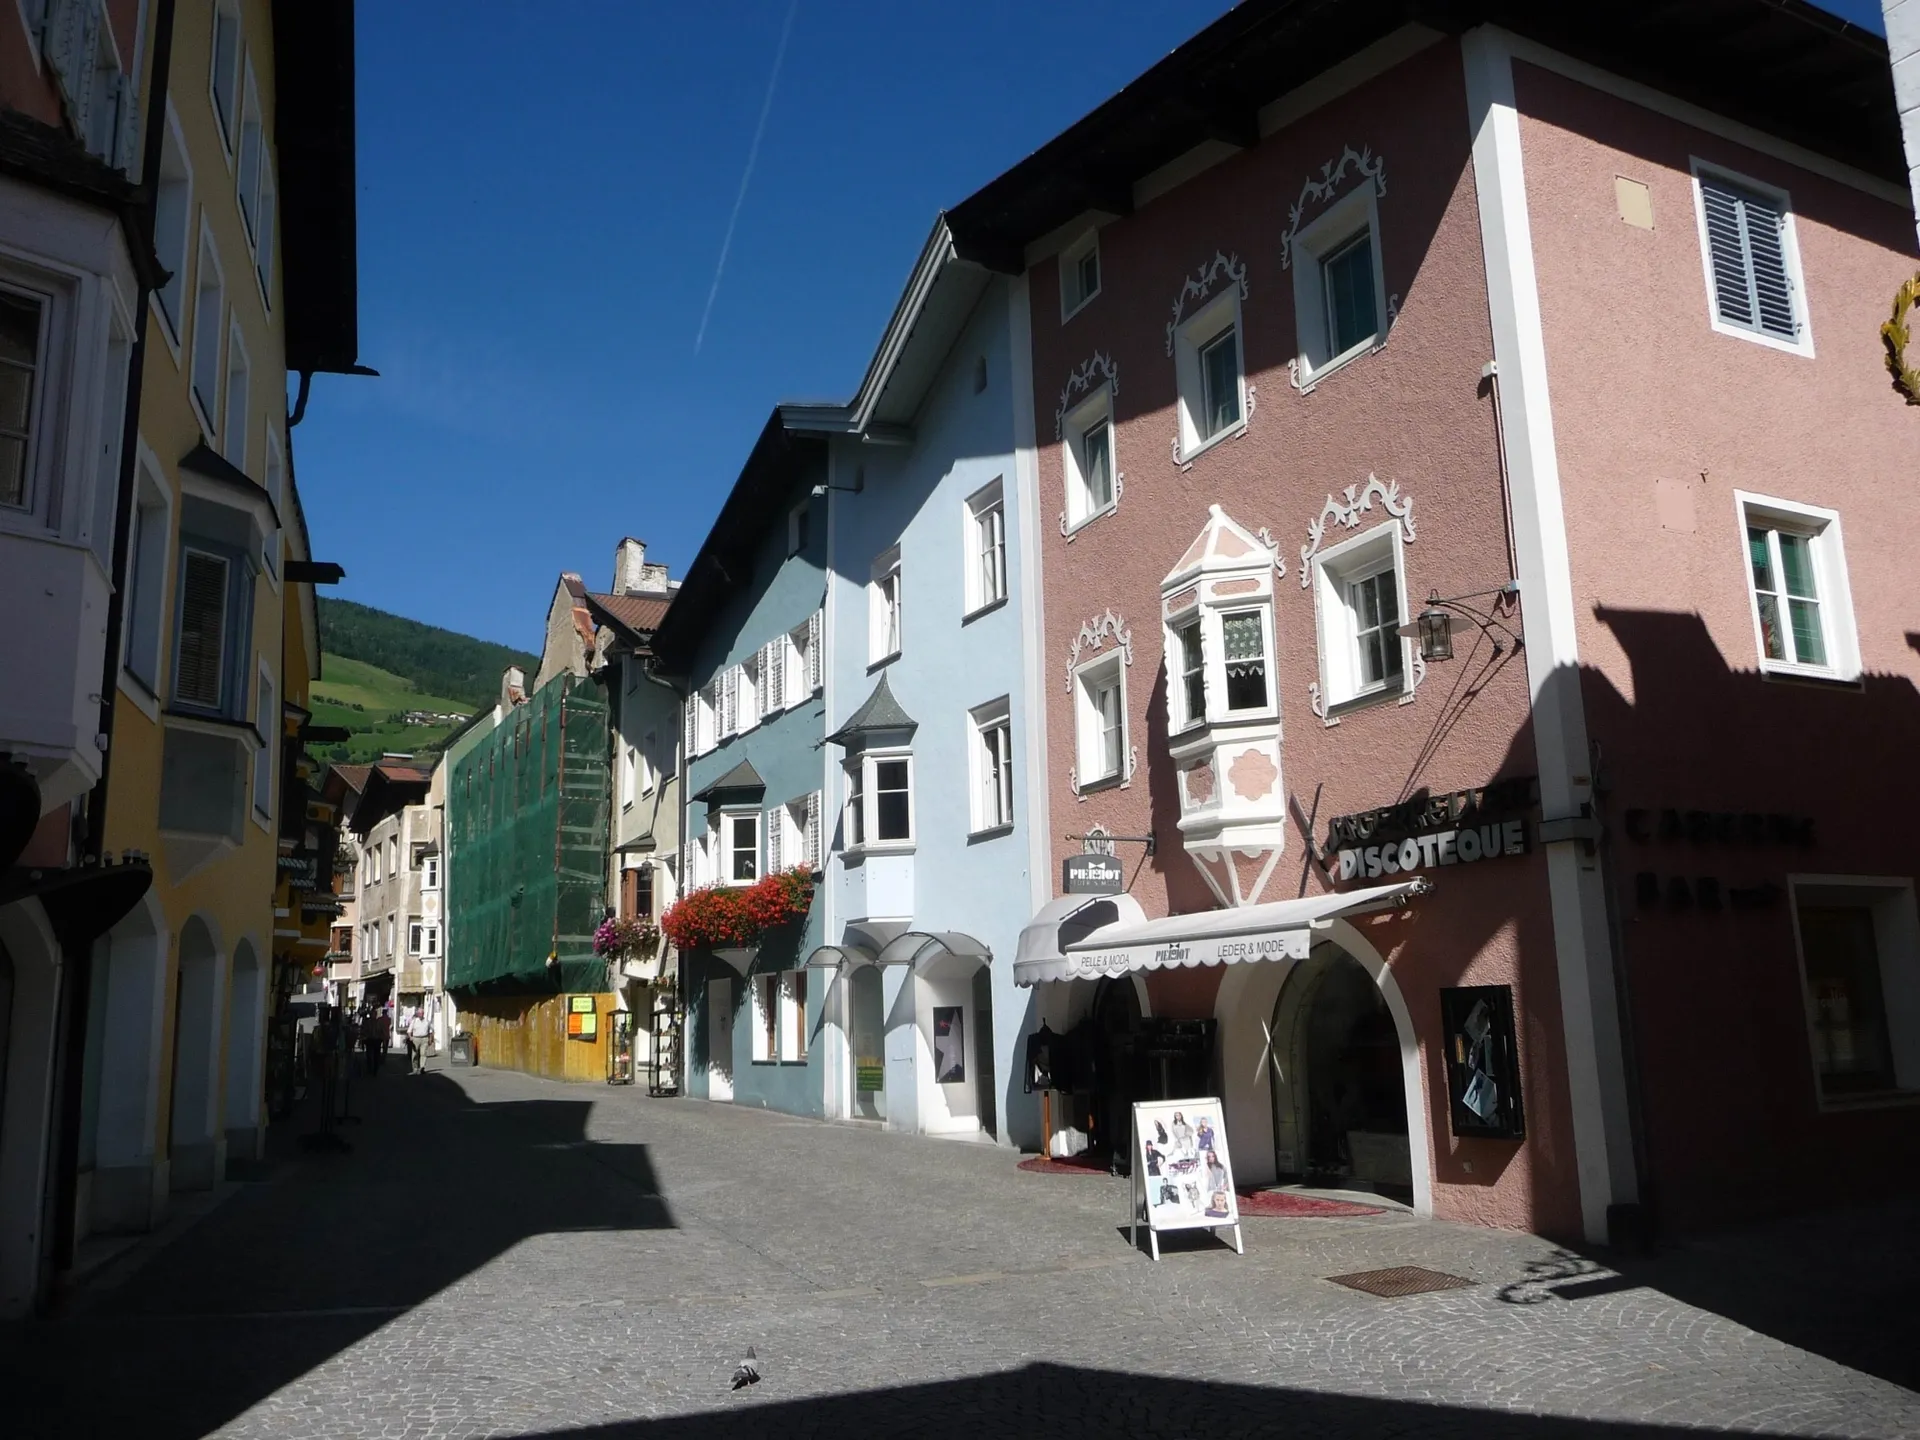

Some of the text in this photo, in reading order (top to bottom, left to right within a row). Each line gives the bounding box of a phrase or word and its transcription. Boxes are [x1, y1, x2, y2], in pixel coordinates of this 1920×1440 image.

[1338, 820, 1525, 882] DISCOTEQUE
[1217, 940, 1284, 957] LEDER & MODE
[1081, 954, 1130, 967] PELLE & MODA
